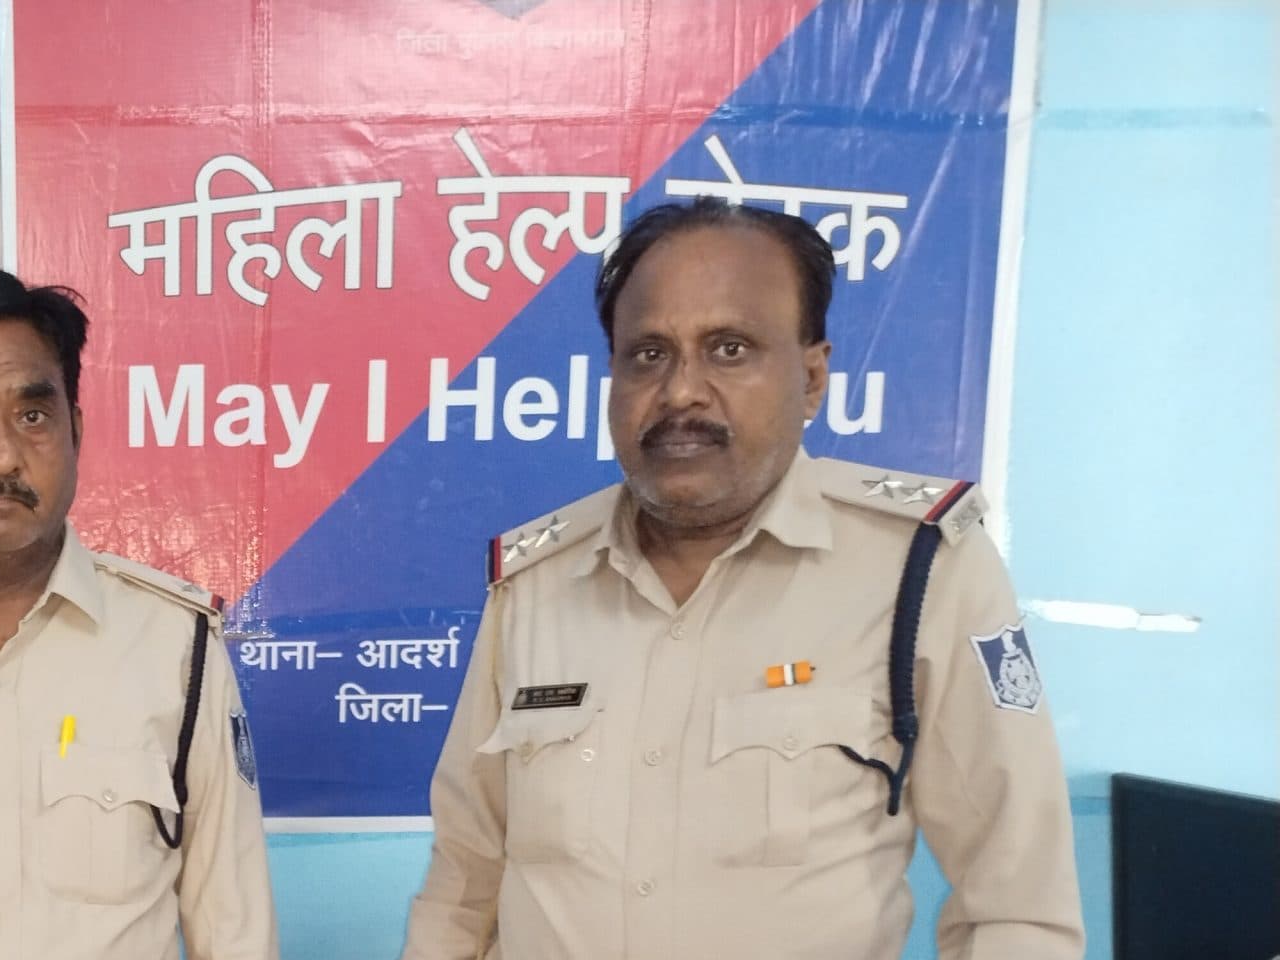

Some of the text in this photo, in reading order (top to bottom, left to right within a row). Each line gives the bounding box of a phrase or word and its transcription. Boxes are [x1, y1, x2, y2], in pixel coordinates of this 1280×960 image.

[108, 154, 403, 306] महिला
[437, 126, 631, 300] हेल्प
[128, 364, 331, 469] May
[367, 359, 388, 443] I
[356, 626, 460, 669] आदर्श
